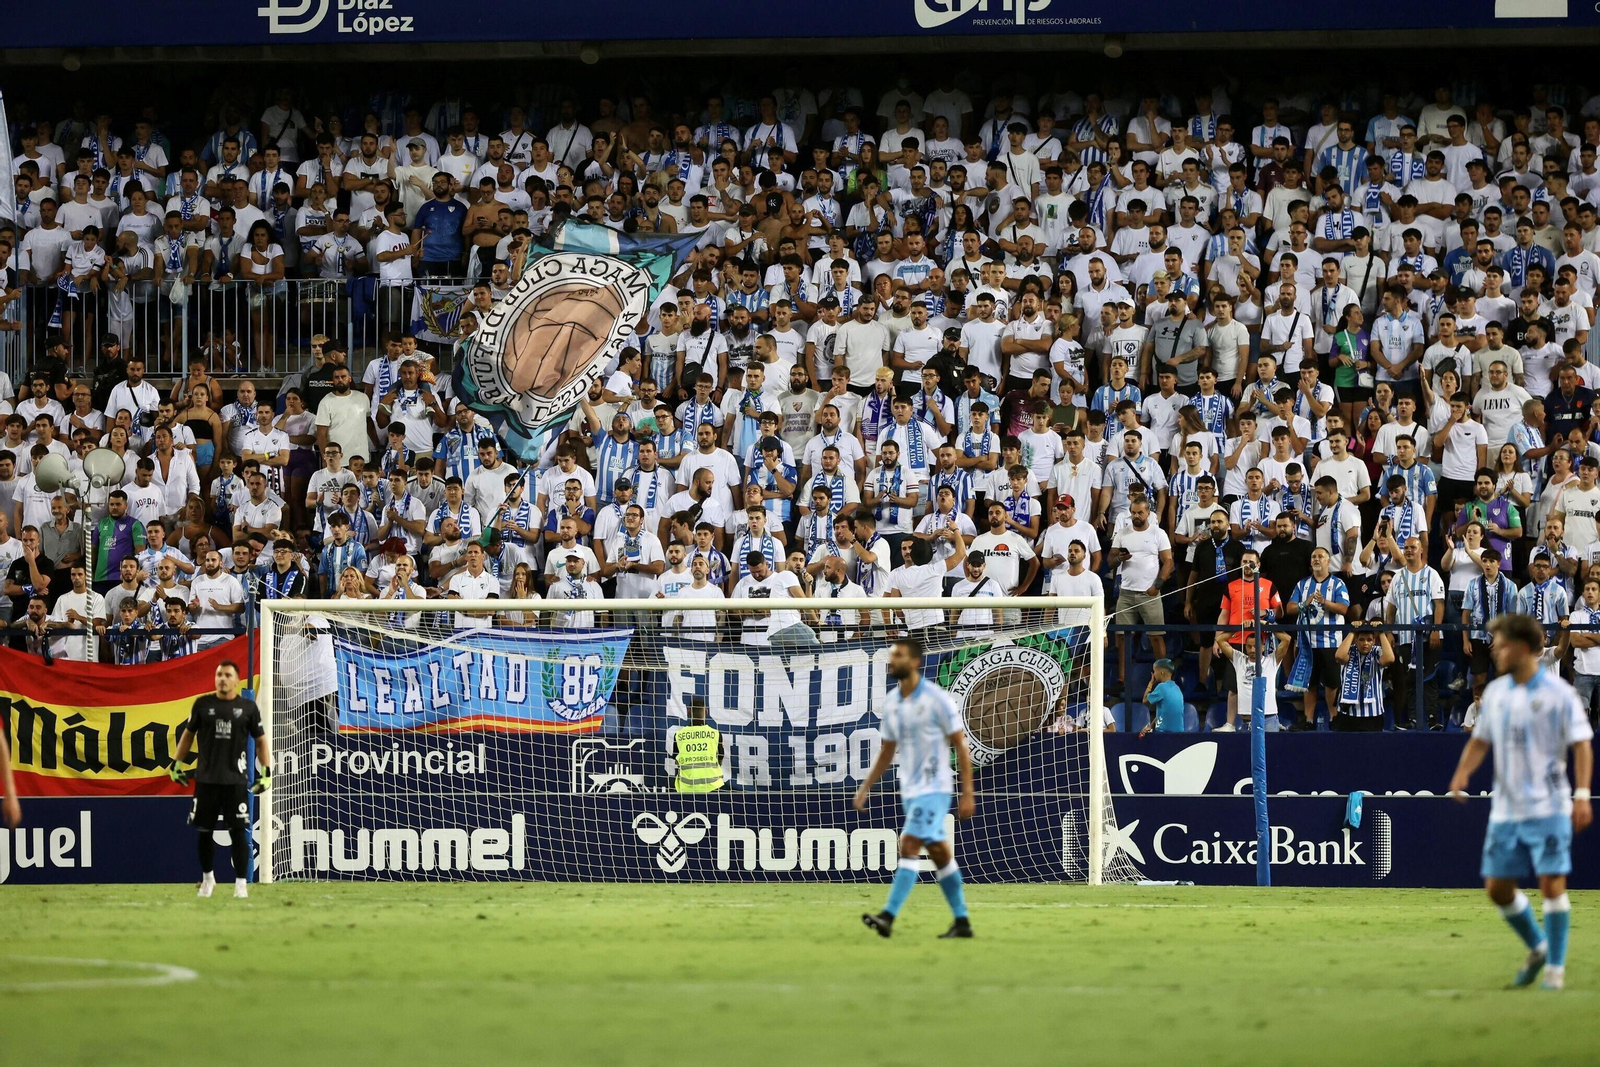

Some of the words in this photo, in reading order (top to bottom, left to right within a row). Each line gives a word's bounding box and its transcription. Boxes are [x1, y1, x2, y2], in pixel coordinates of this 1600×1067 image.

[337, 12, 415, 36] López
[972, 18, 1014, 26] PREVENCIÓN
[1065, 17, 1102, 25] LABORALES
[345, 651, 529, 715] LEALTAD
[562, 653, 603, 707] 86
[953, 651, 1014, 697] MALAGA
[1018, 650, 1054, 674] CLUB
[548, 696, 608, 721] MALAGA
[0, 697, 200, 775] Mála
[677, 730, 716, 742] SEGURIDAD
[685, 742, 708, 752] 0032
[311, 742, 486, 776] Provincial
[788, 728, 902, 786] 190
[290, 814, 526, 872] hummel
[717, 813, 955, 872] humml
